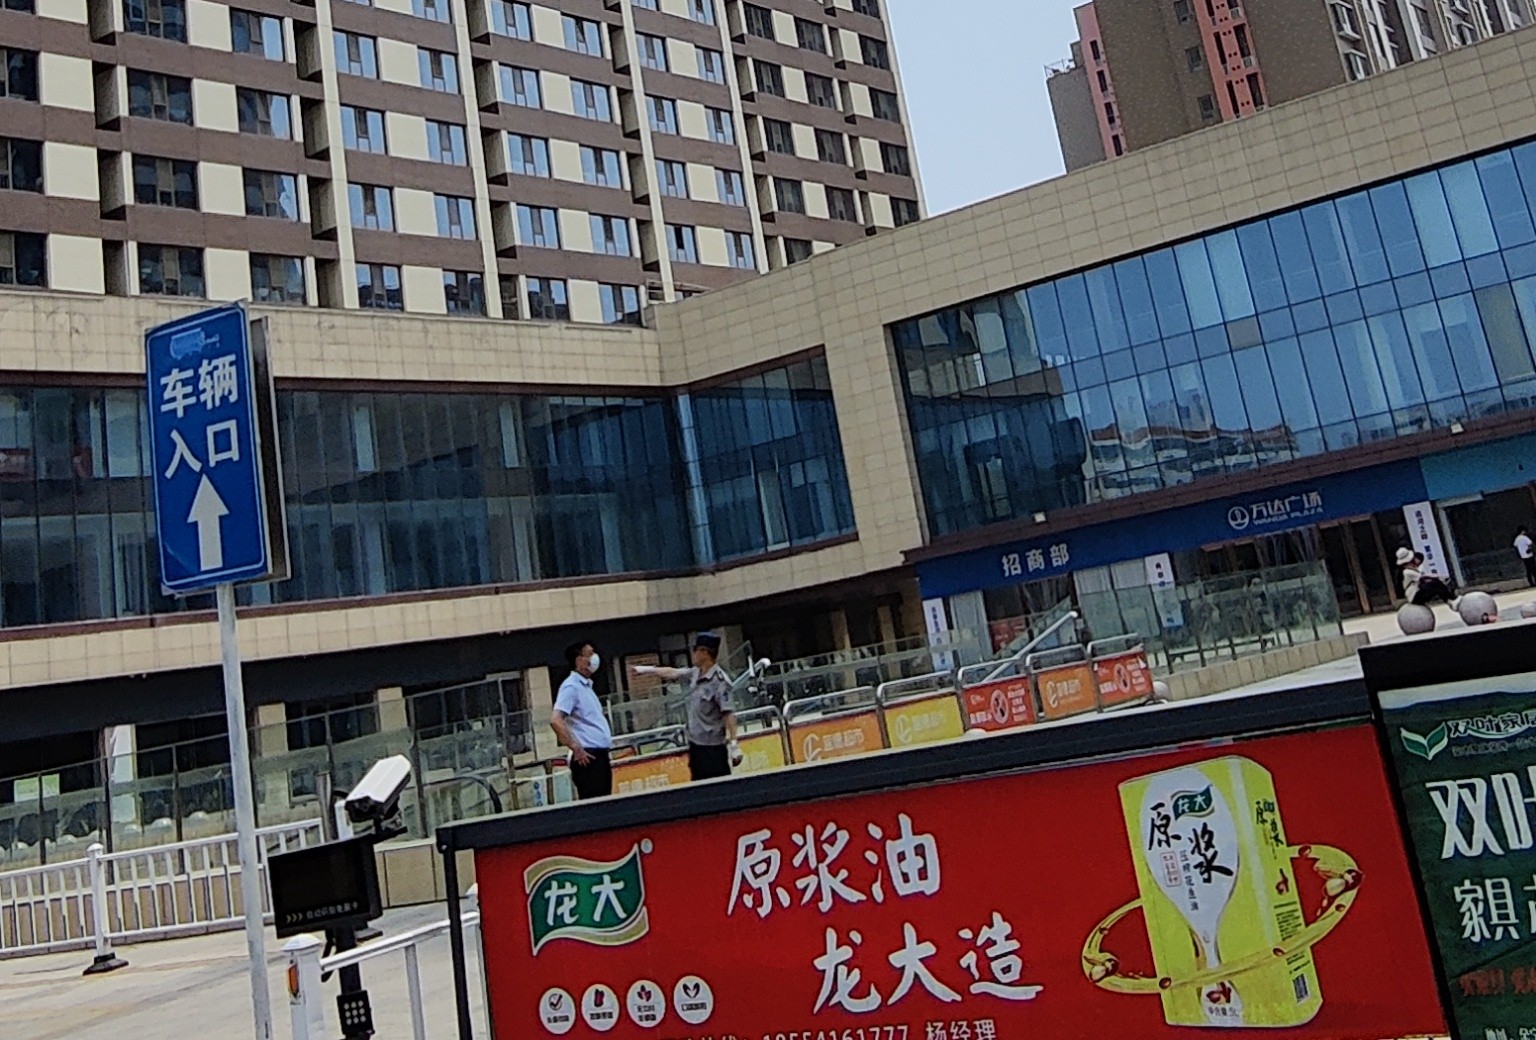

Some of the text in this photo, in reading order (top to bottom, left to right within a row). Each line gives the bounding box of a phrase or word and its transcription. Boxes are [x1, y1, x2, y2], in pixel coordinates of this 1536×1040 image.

[160, 353, 238, 419] 车辆
[164, 418, 241, 480] 入口
[1249, 491, 1323, 519] 万达广场
[1001, 543, 1070, 577] 招商部
[1177, 793, 1210, 812] 龙大
[726, 813, 942, 921] 原浆油
[544, 874, 628, 926] 龙大
[814, 913, 1044, 1016] 龙大造
[926, 1018, 999, 1040] 杨经理
